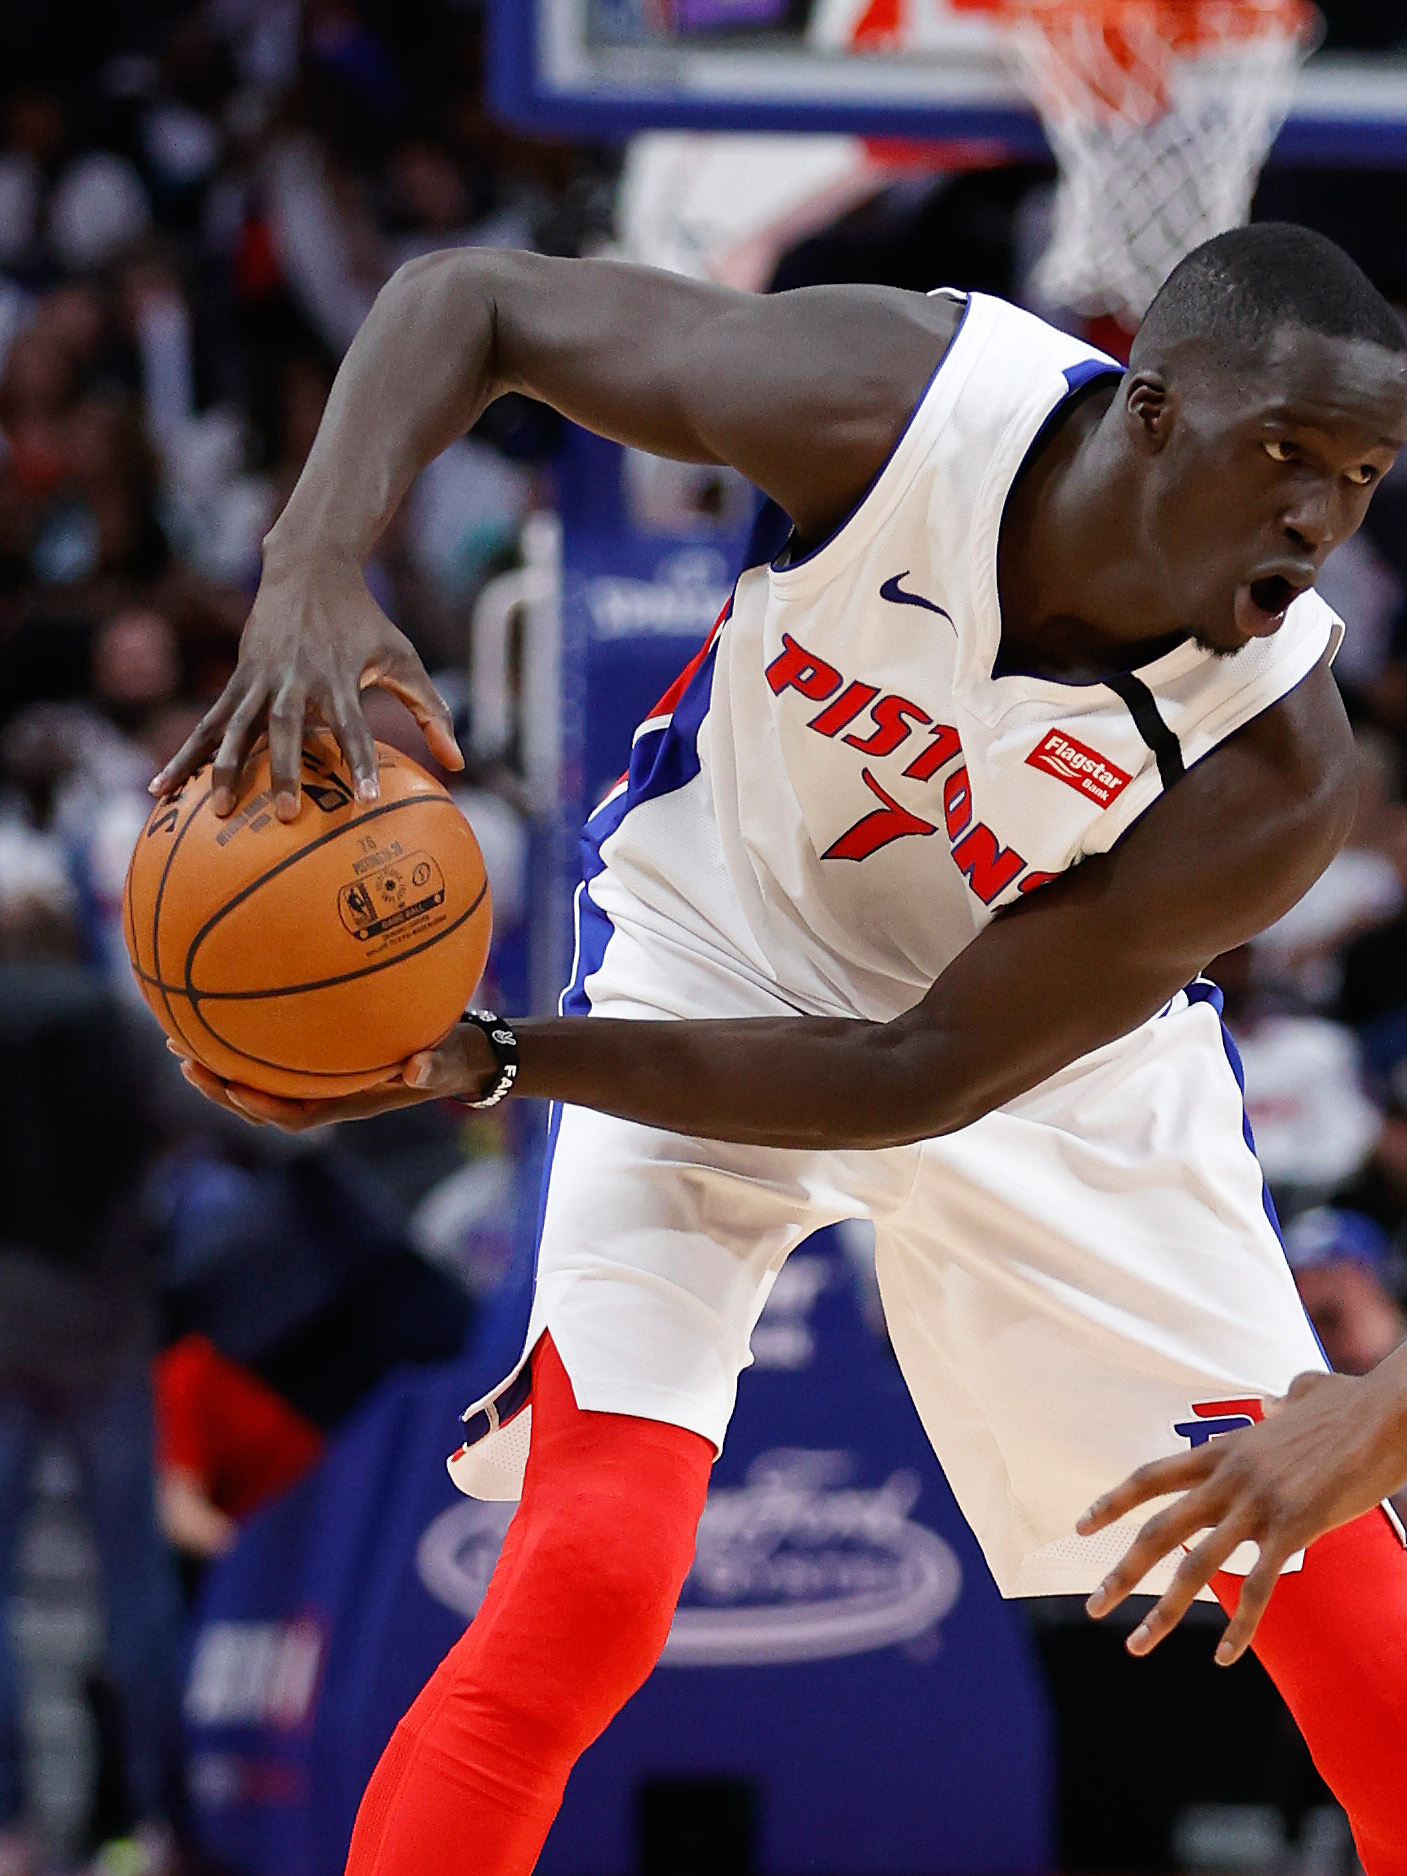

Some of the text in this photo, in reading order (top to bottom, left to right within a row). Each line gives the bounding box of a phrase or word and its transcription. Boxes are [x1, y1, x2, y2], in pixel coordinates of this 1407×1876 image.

[1044, 735, 1123, 789] Flagstar
[820, 767, 939, 862] 7
[1081, 778, 1110, 801] Bank
